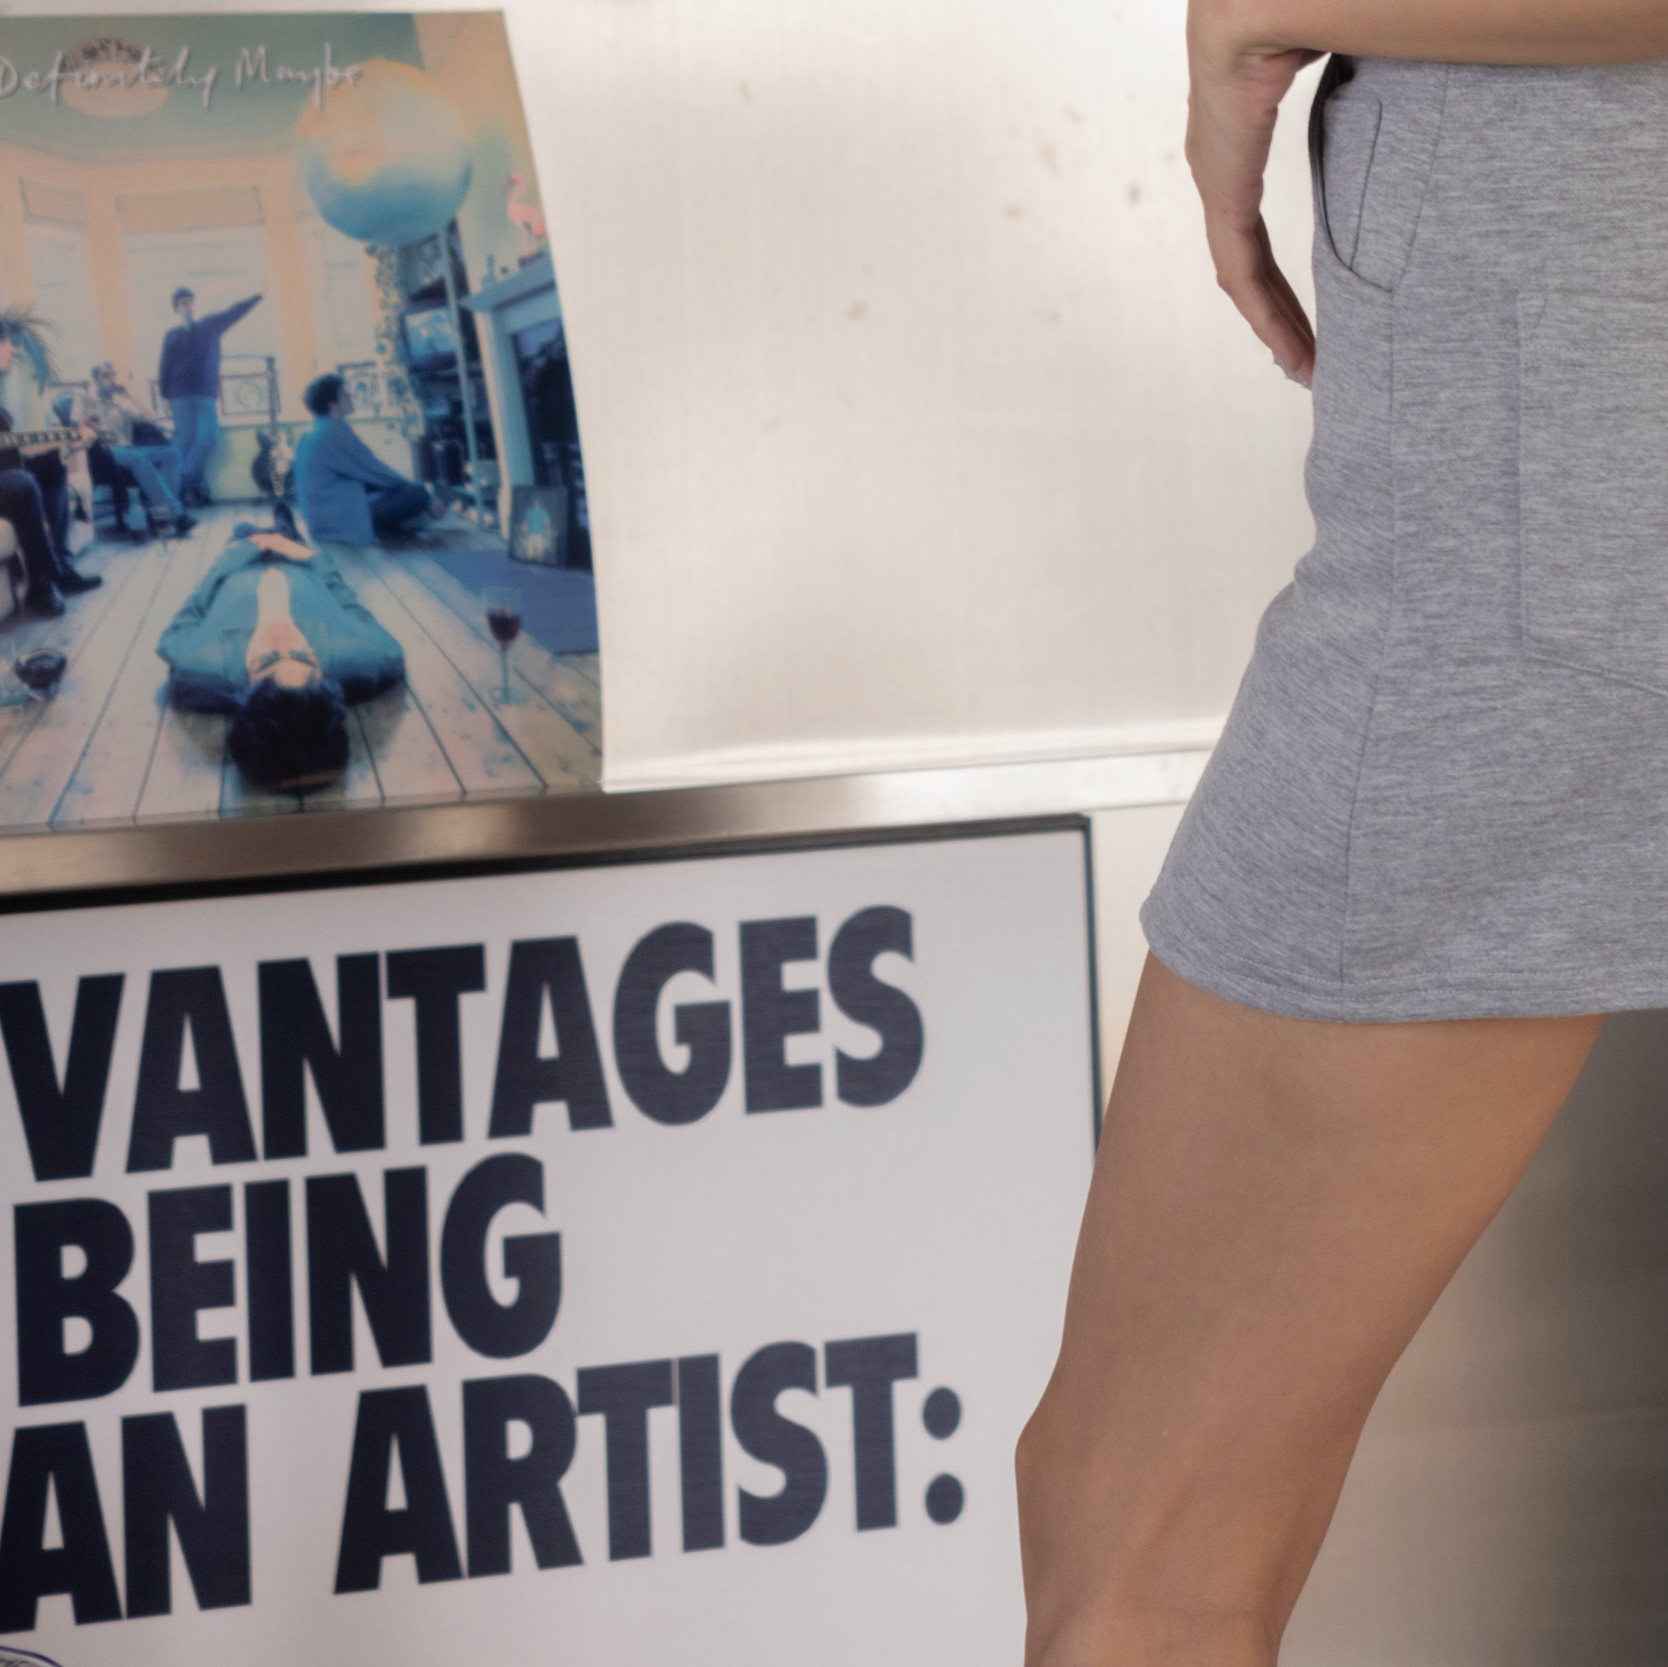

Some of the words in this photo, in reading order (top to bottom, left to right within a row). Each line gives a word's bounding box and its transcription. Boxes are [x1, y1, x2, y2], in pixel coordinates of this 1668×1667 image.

[236, 42, 363, 107] Maybe
[0, 905, 925, 1182] VANTAGES
[13, 1152, 562, 1407] BEING
[0, 1404, 252, 1634] AN
[333, 1331, 965, 1595] ARTIST:
